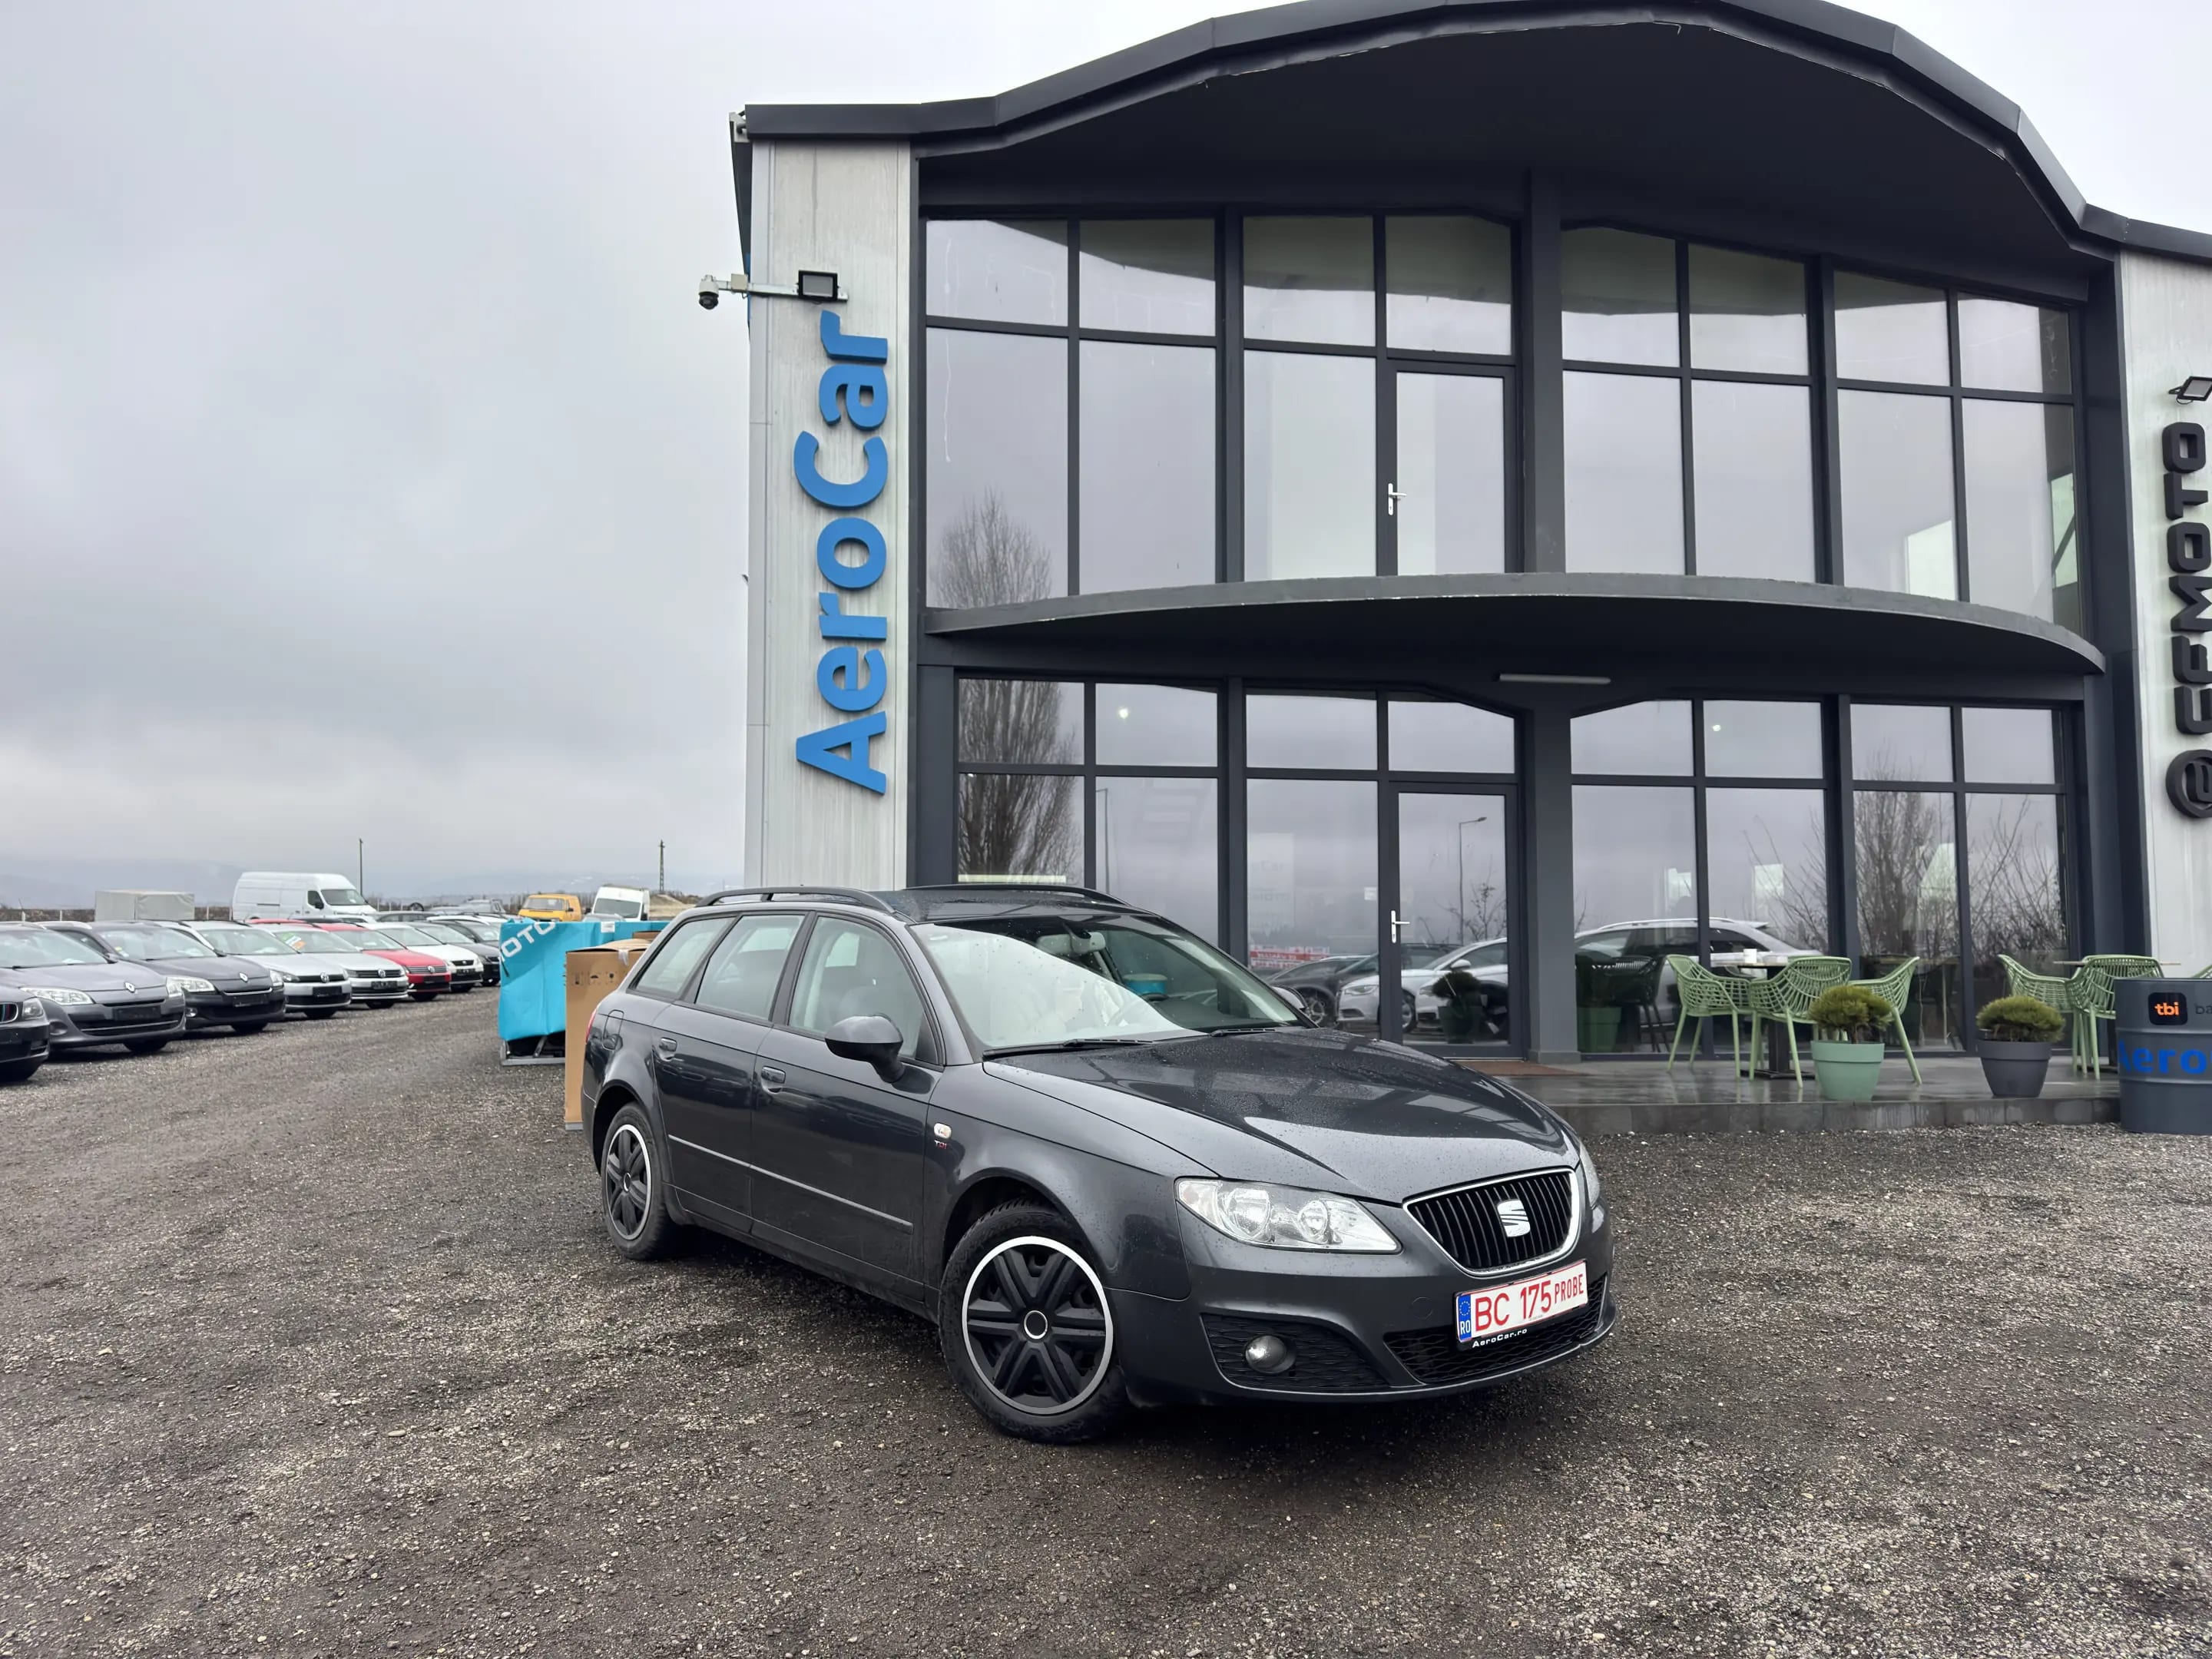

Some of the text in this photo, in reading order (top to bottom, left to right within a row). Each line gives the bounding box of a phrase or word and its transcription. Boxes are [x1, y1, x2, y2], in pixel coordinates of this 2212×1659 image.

[793, 309, 889, 796] AeroCar
[2162, 421, 2212, 736] CFMOTO
[2154, 1002, 2180, 1015] tbi
[2118, 1038, 2212, 1075] Aero
[1475, 1273, 1584, 1332] BC 175 PROBE
[1460, 1320, 1471, 1335] RO
[1472, 1328, 1528, 1349] AeroCar.ro
